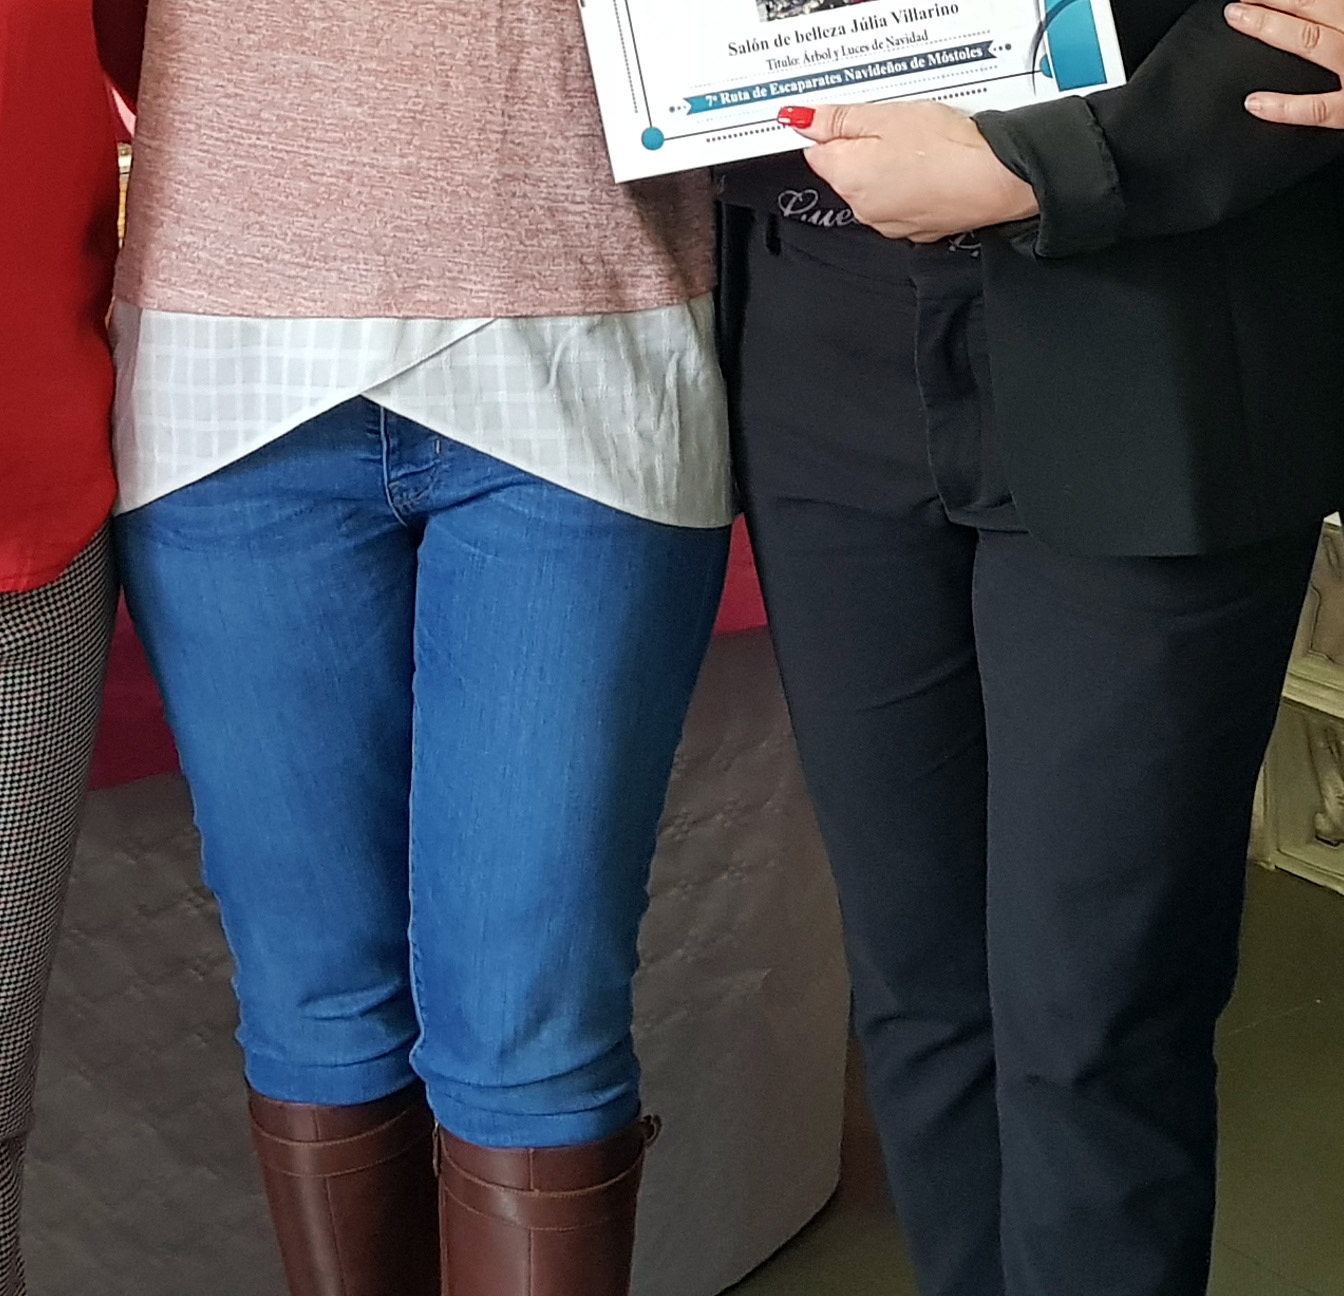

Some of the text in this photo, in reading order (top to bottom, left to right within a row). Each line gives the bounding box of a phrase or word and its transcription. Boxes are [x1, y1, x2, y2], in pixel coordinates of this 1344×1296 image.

[728, 0, 960, 57] Salón de belleza Júlia Villarino
[803, 45, 832, 65] Árbol
[834, 49, 840, 63] y
[841, 41, 870, 58] Luces
[872, 37, 884, 51] de
[885, 29, 929, 49] Navidad
[720, 88, 751, 105] Ruta
[752, 85, 768, 99] de
[769, 71, 843, 97] Escaparates
[844, 58, 907, 83] Navideños
[909, 55, 926, 70] de
[927, 43, 984, 66] Móstoles
